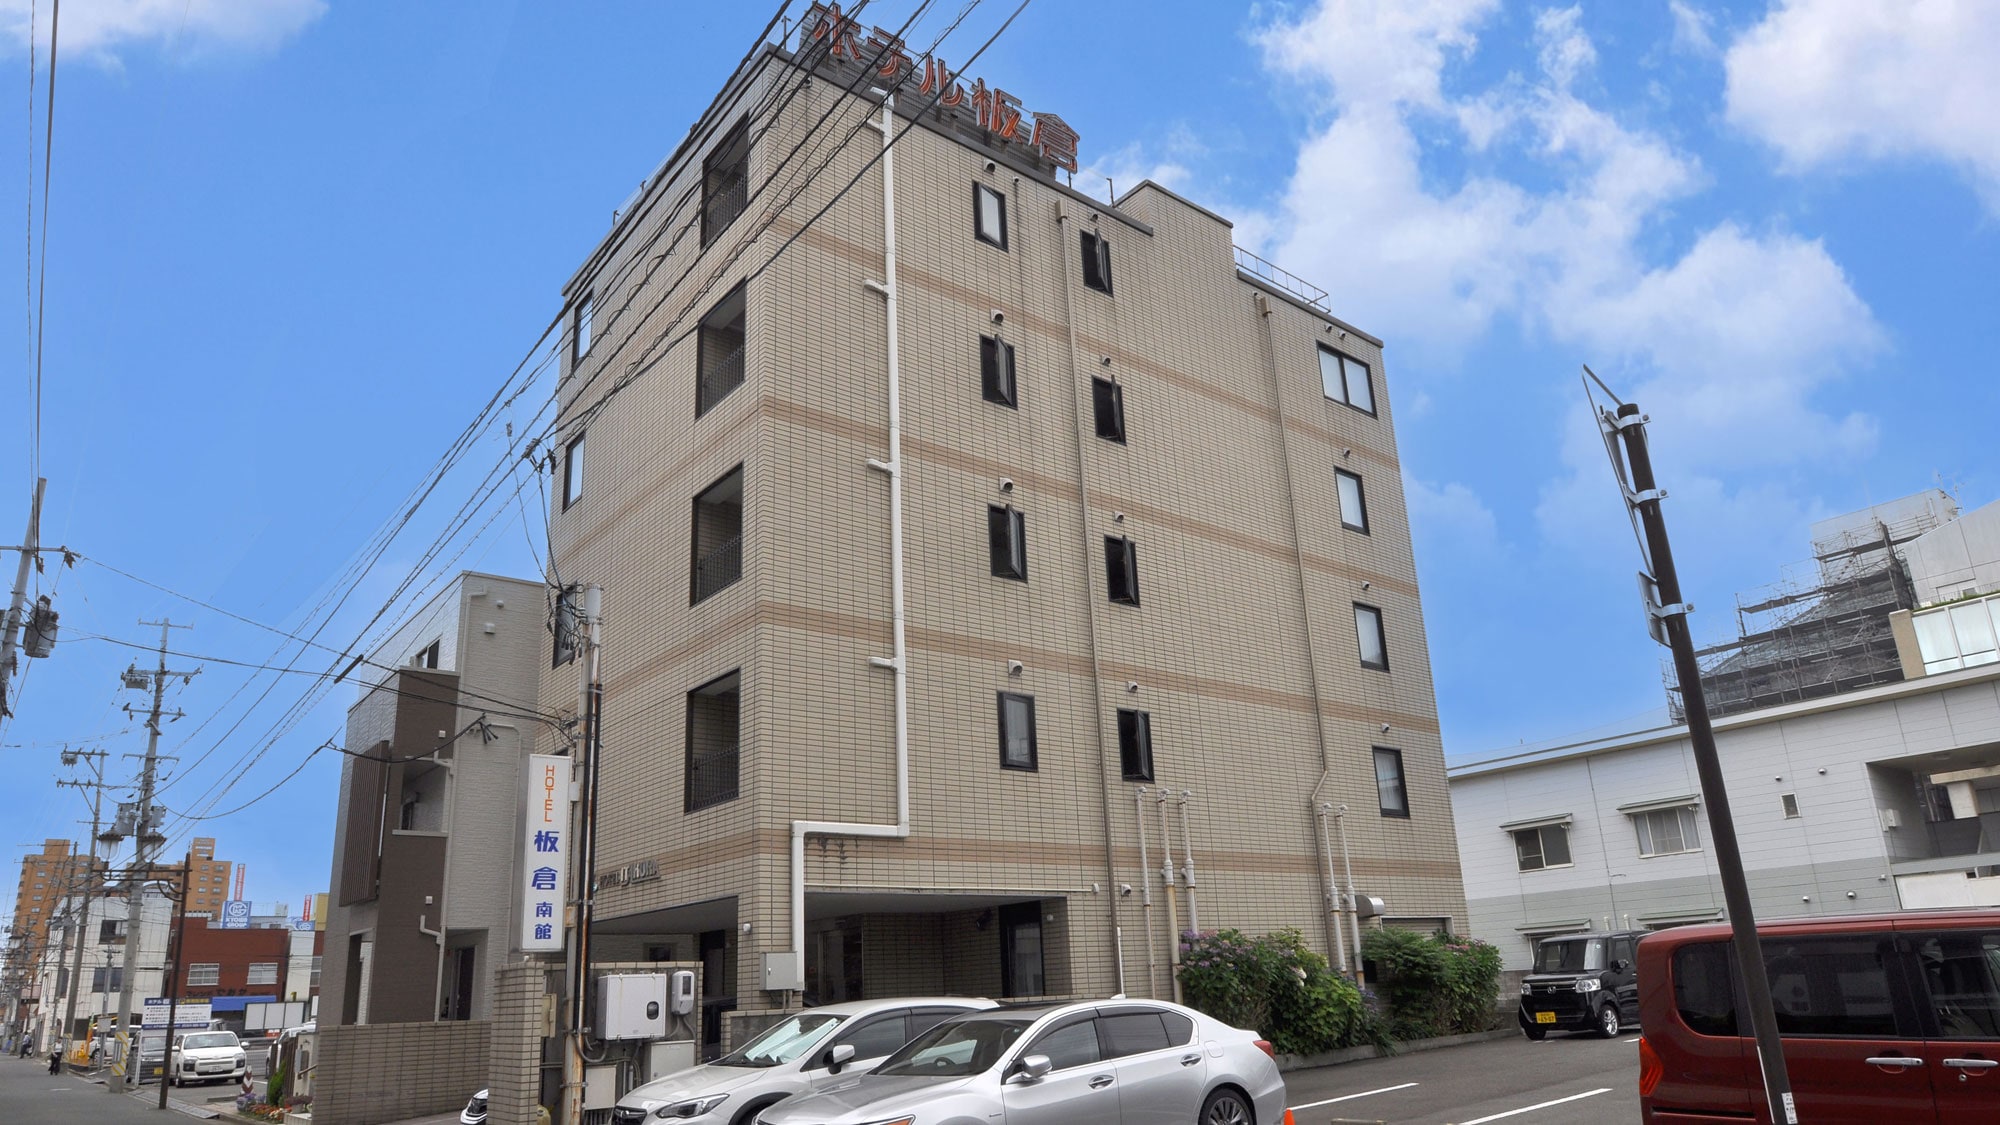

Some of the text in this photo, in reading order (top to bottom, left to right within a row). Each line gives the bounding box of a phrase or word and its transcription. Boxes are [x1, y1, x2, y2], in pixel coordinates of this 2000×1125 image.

[813, 2, 1080, 174] ホテル板倉
[531, 764, 560, 940] HOTEL 板倉南館
